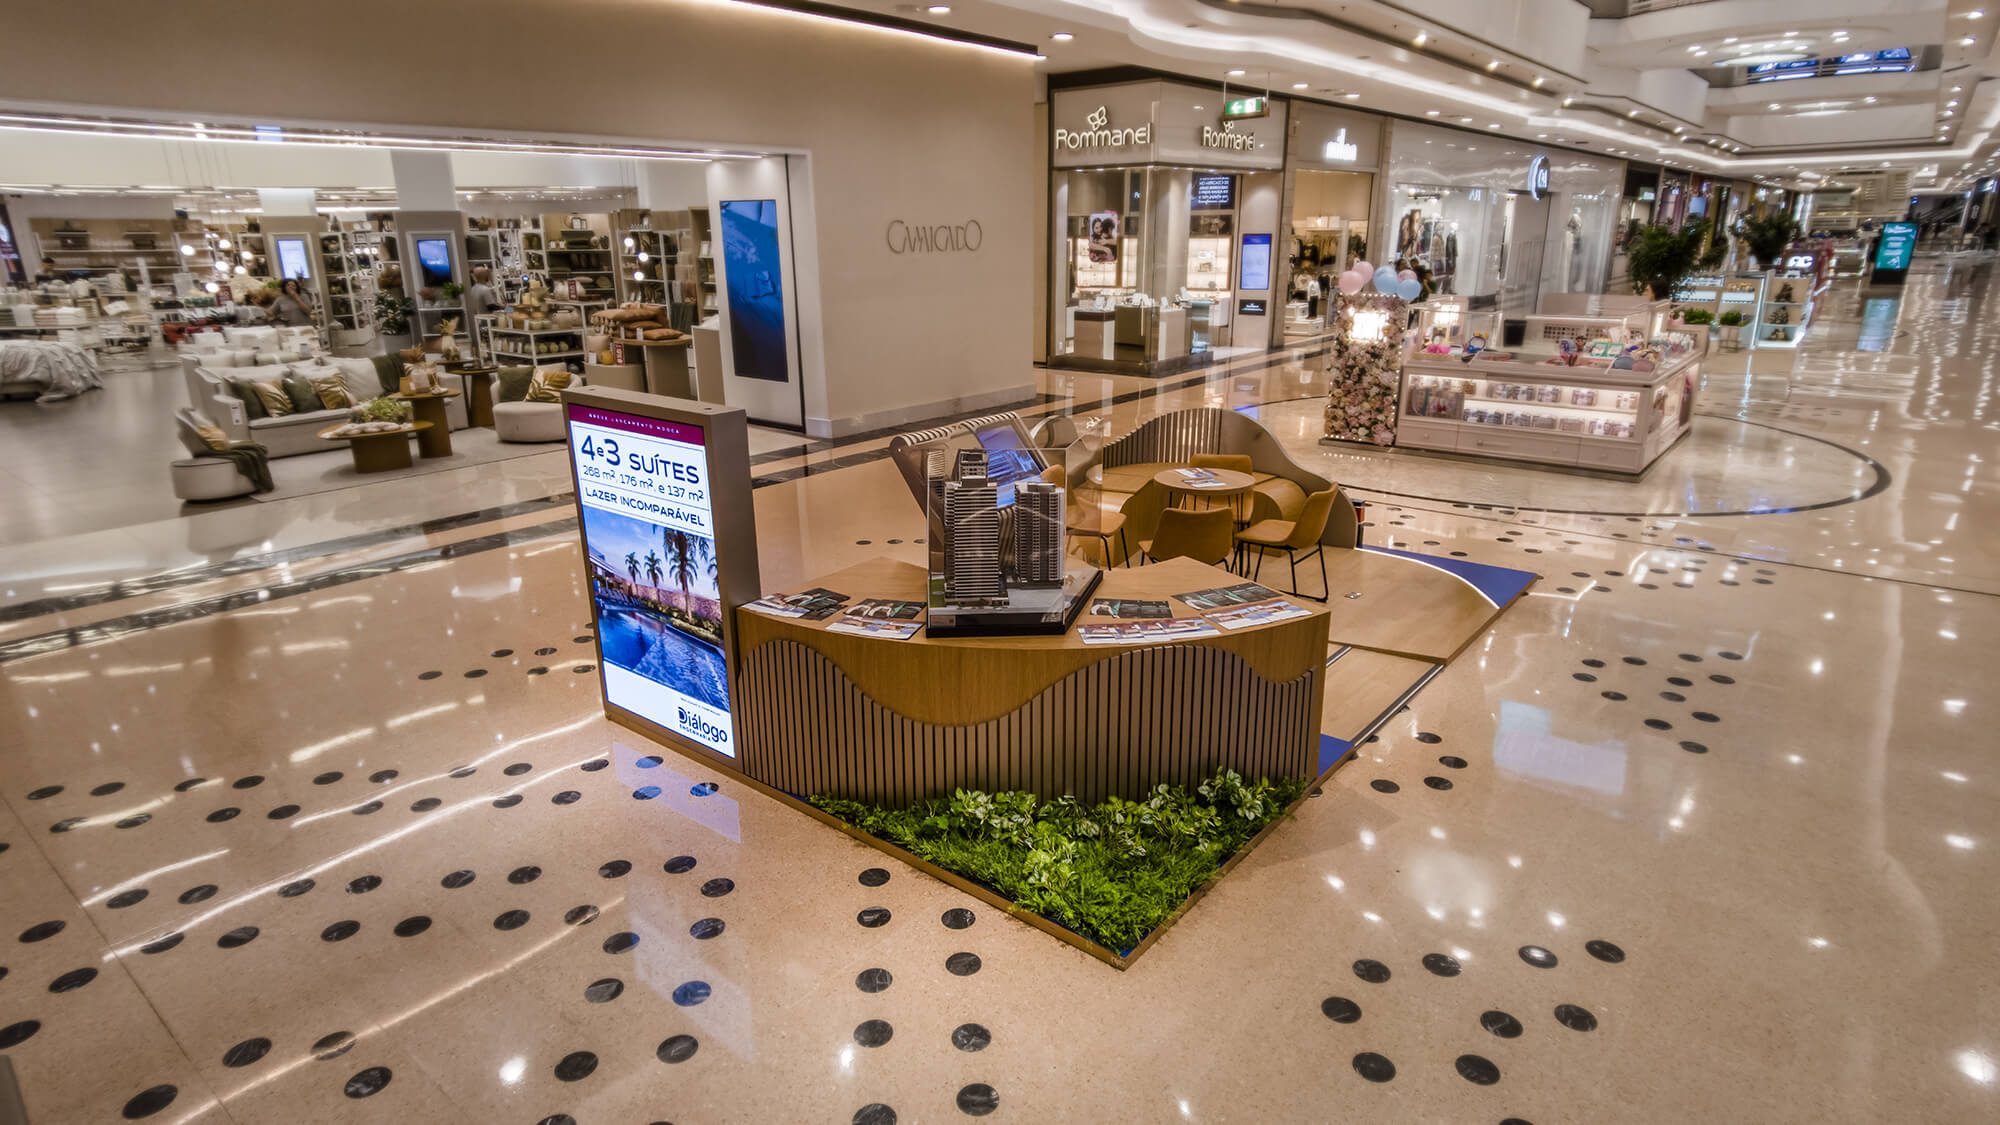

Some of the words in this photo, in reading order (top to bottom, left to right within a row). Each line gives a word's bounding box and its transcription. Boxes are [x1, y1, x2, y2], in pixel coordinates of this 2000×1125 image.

[1055, 122, 1151, 149] Rommanel
[1203, 126, 1255, 151] Rommanel
[887, 219, 982, 254] CAMICADO
[583, 465, 601, 478] 268
[620, 473, 638, 487] 176
[658, 484, 665, 493] e
[667, 485, 685, 498] 137
[629, 453, 700, 484] SUÍTES
[585, 487, 618, 504] LAZER
[619, 495, 705, 527] INCOMPARÁVEL
[678, 706, 728, 743] Diálogo
